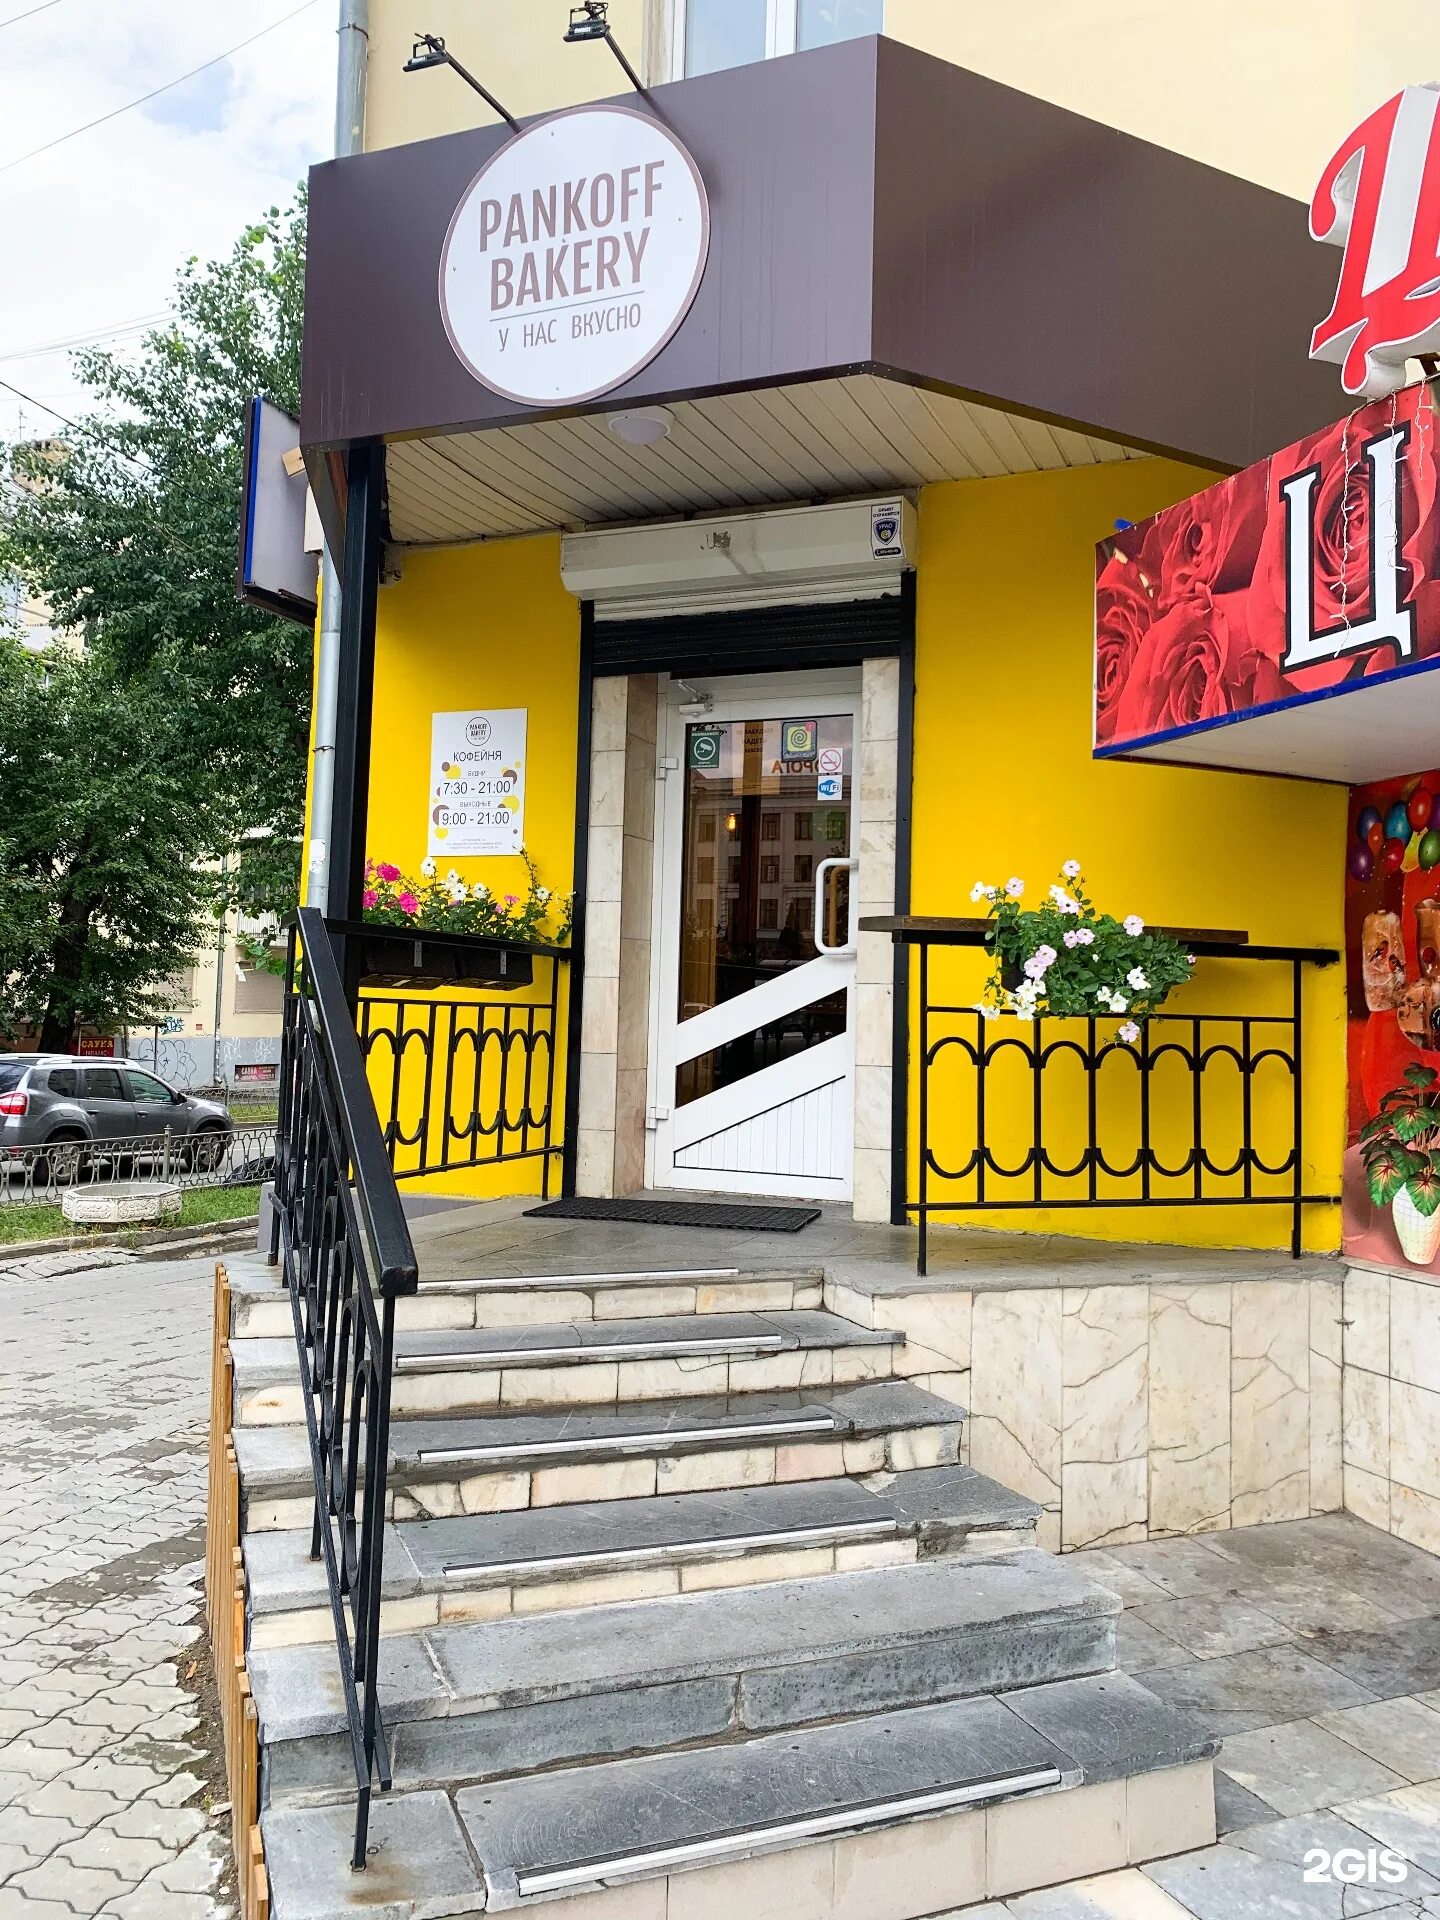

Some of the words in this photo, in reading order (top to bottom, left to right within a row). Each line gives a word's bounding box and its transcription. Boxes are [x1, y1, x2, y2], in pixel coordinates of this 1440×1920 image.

[479, 160, 665, 252] PANKOFF
[490, 227, 651, 311] BAKERY
[498, 327, 509, 352] У
[523, 319, 557, 348] НАС
[571, 303, 641, 339] ВКУСНО
[1280, 420, 1416, 676] Ц
[453, 750, 502, 762] КОФЕЙНЯ
[443, 782, 468, 795] 7:30
[478, 780, 511, 794] 21:00
[442, 812, 467, 825] 9:00
[477, 811, 510, 825] 21:00
[81, 1040, 114, 1048] САУНА
